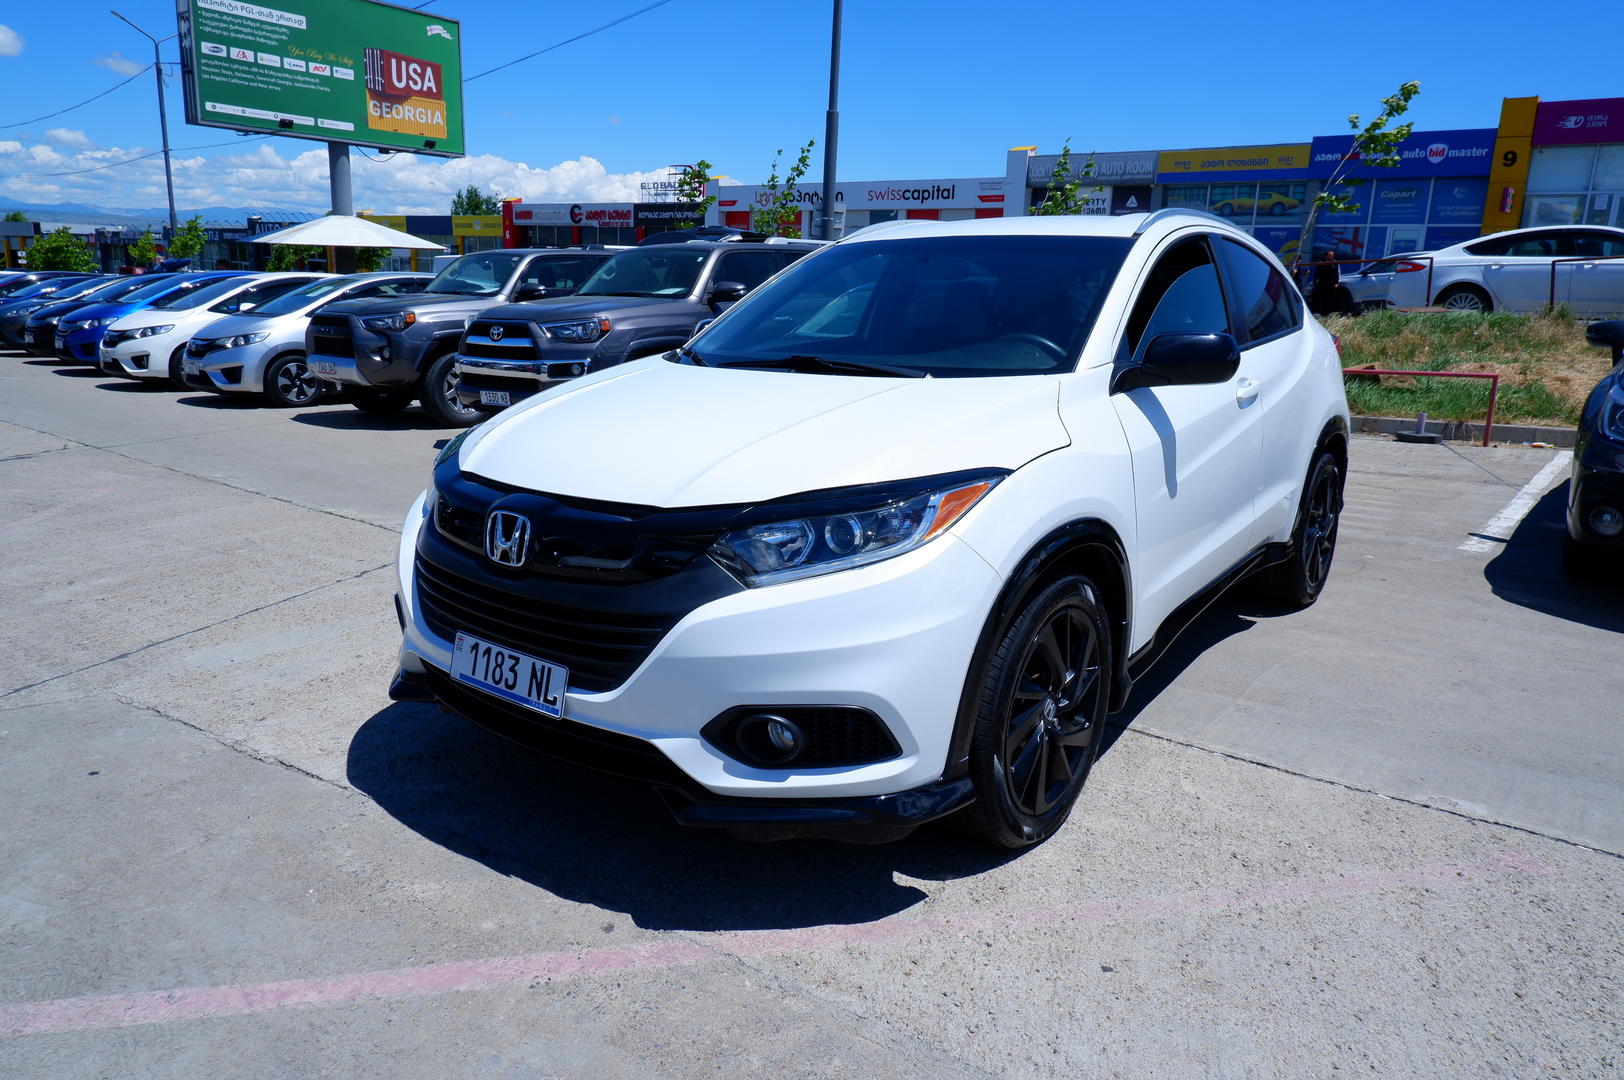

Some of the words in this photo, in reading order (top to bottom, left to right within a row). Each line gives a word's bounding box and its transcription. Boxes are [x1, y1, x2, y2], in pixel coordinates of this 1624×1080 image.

[240, 5, 274, 19] PGL-თან
[276, 14, 304, 26] ერთად
[390, 58, 437, 93] USA
[369, 100, 445, 126] GEORGIA
[1402, 149, 1426, 159] auto
[1429, 146, 1446, 157] bid
[1448, 147, 1488, 158] master
[1502, 150, 1518, 167] 9
[1100, 161, 1124, 175] AUTO
[1126, 159, 1153, 174] ROOM
[867, 184, 956, 204] swisscapital
[1380, 190, 1416, 200] Copart
[505, 230, 510, 239] 6
[470, 641, 520, 691] 1183
[527, 661, 558, 707] NL
